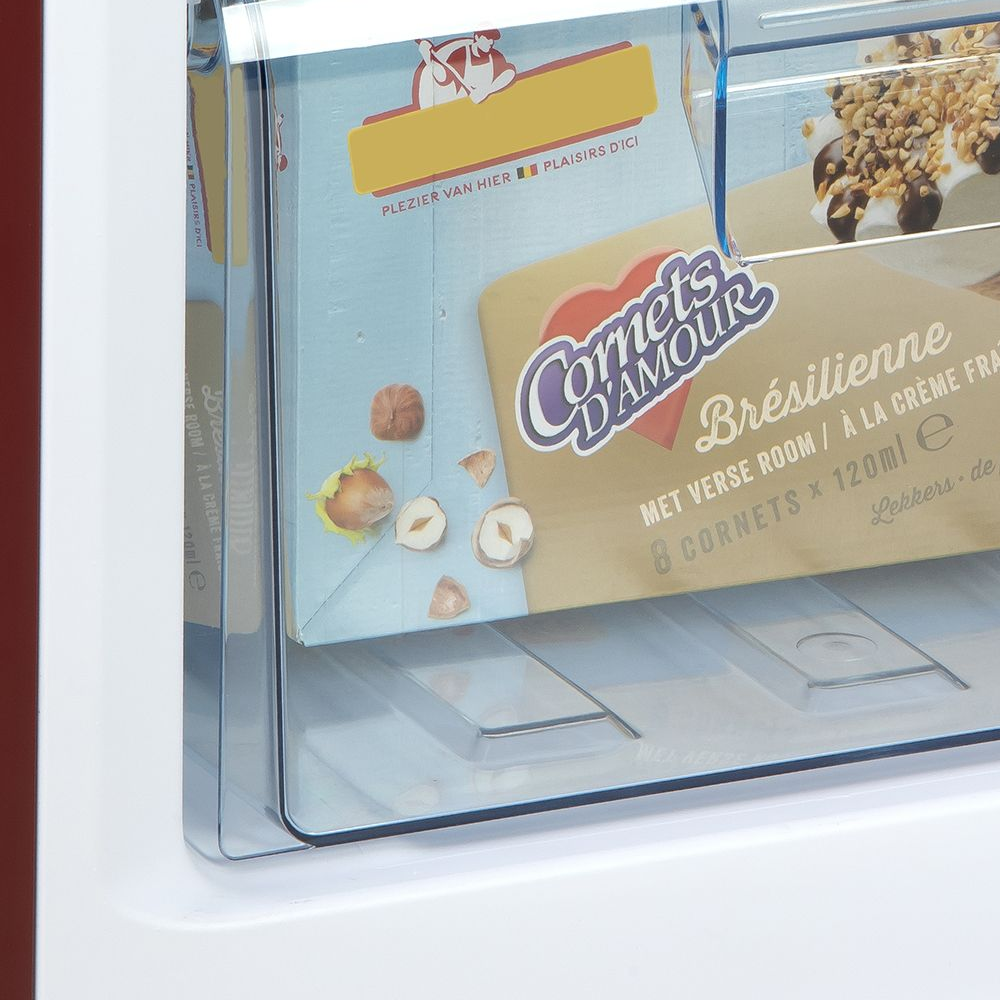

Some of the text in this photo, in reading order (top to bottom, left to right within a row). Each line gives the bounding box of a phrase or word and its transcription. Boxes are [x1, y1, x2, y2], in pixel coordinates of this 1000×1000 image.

[381, 135, 639, 216] PLEZIER VAN HIER PLAISIRS D'ICI
[528, 258, 719, 438] Cornets
[580, 283, 766, 442] D'AMOUR
[694, 320, 953, 453] Brésilienne
[639, 490, 683, 527] MET
[687, 458, 760, 505] VERSE
[758, 431, 817, 475] ROOM
[842, 408, 858, 439] À
[860, 405, 889, 431] LA
[892, 374, 961, 416] CRÈME
[650, 538, 672, 575] 8
[681, 490, 801, 562] CORNETS
[832, 432, 909, 493] 120ml
[871, 477, 955, 526] Lekkers
[970, 458, 996, 481] de
